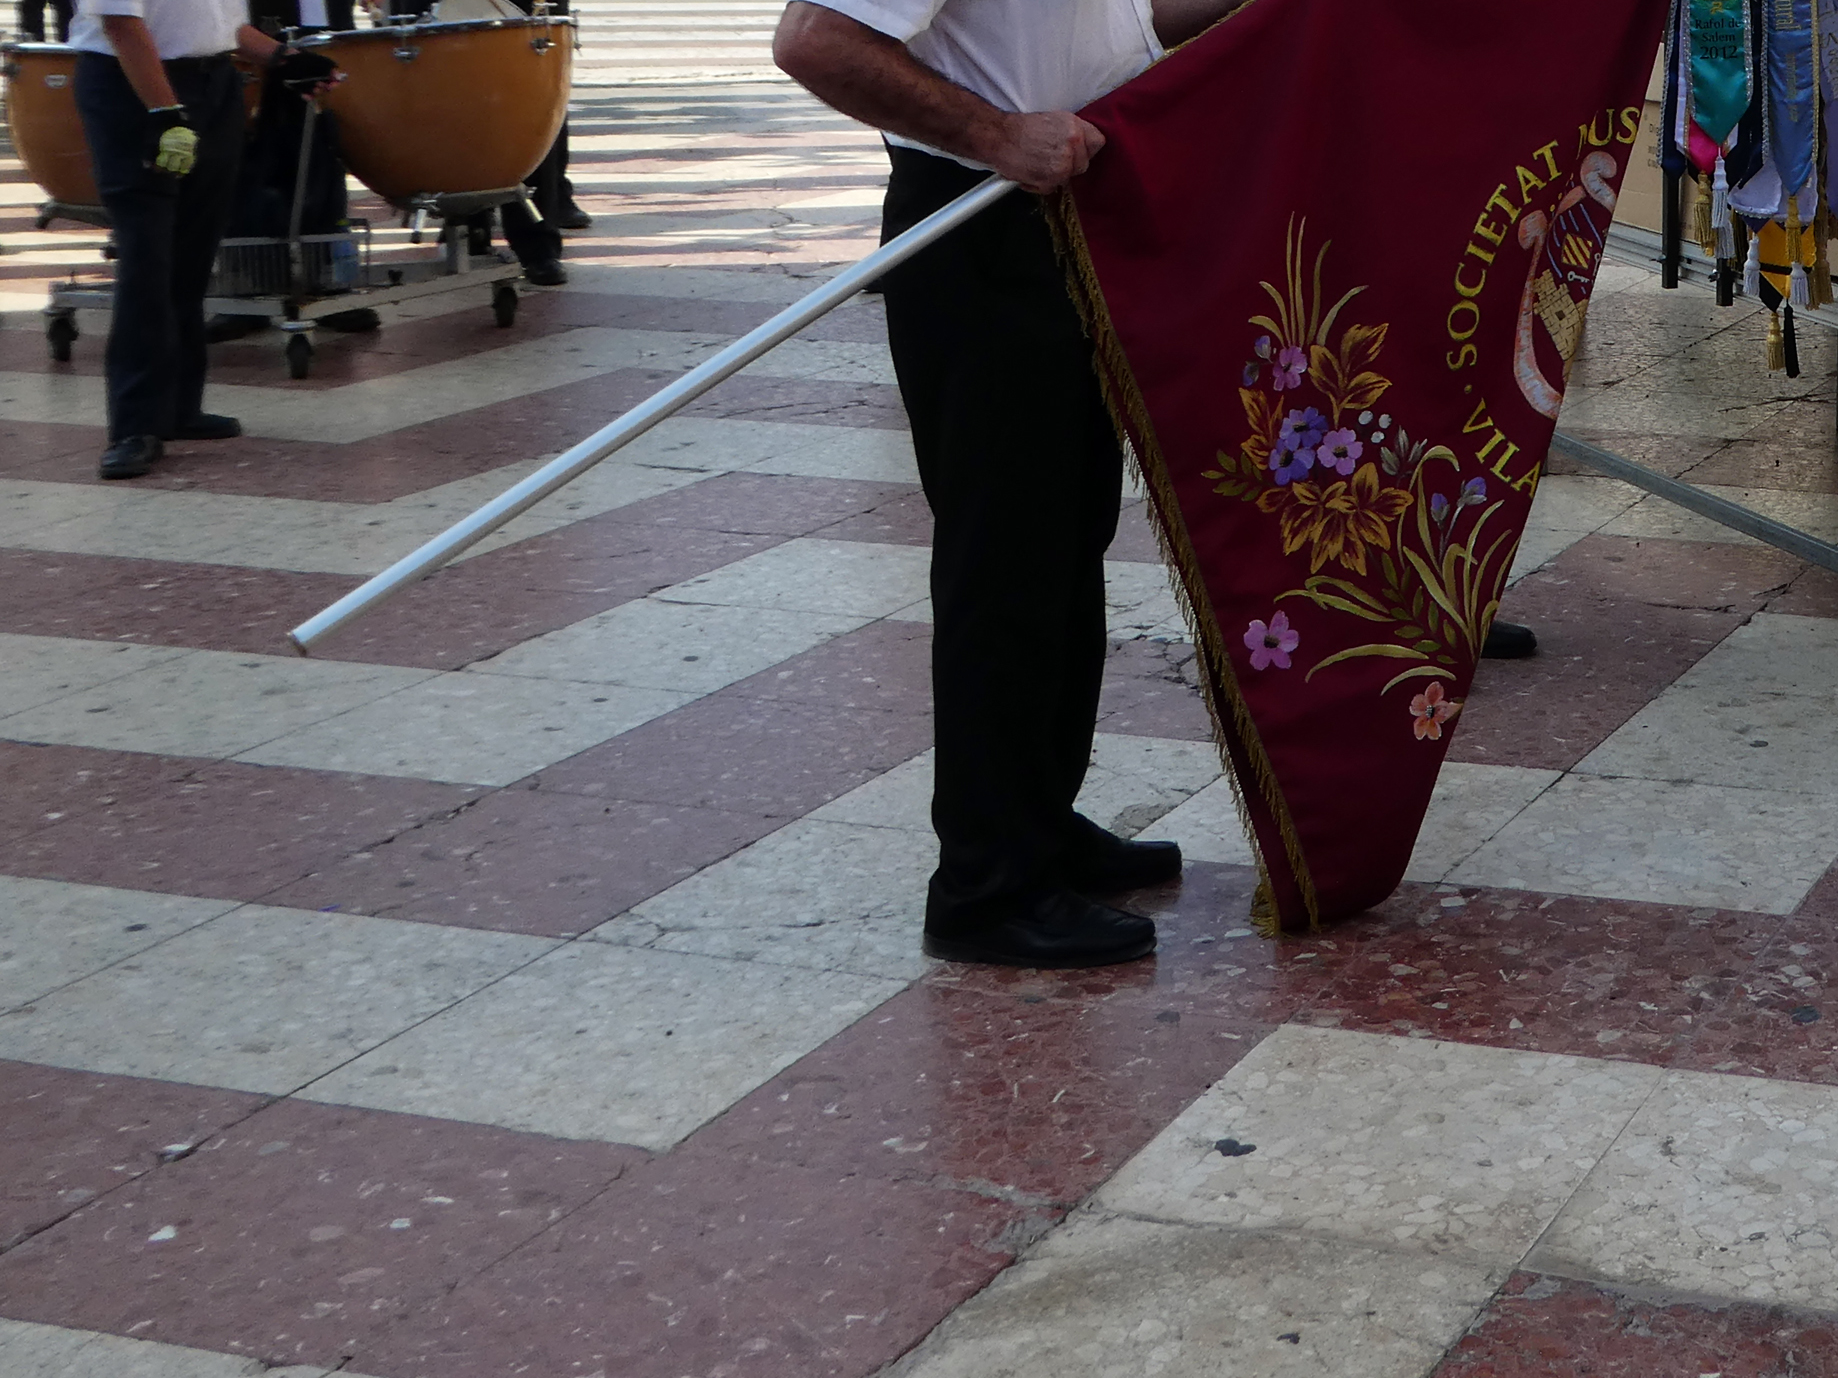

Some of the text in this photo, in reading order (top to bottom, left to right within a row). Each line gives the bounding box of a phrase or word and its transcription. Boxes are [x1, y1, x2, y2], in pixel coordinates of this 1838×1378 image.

[1700, 45, 1738, 60] 2012
[1702, 31, 1736, 42] Salem
[1446, 139, 1563, 371] SOCIETAT
[1461, 397, 1542, 499] VILA
